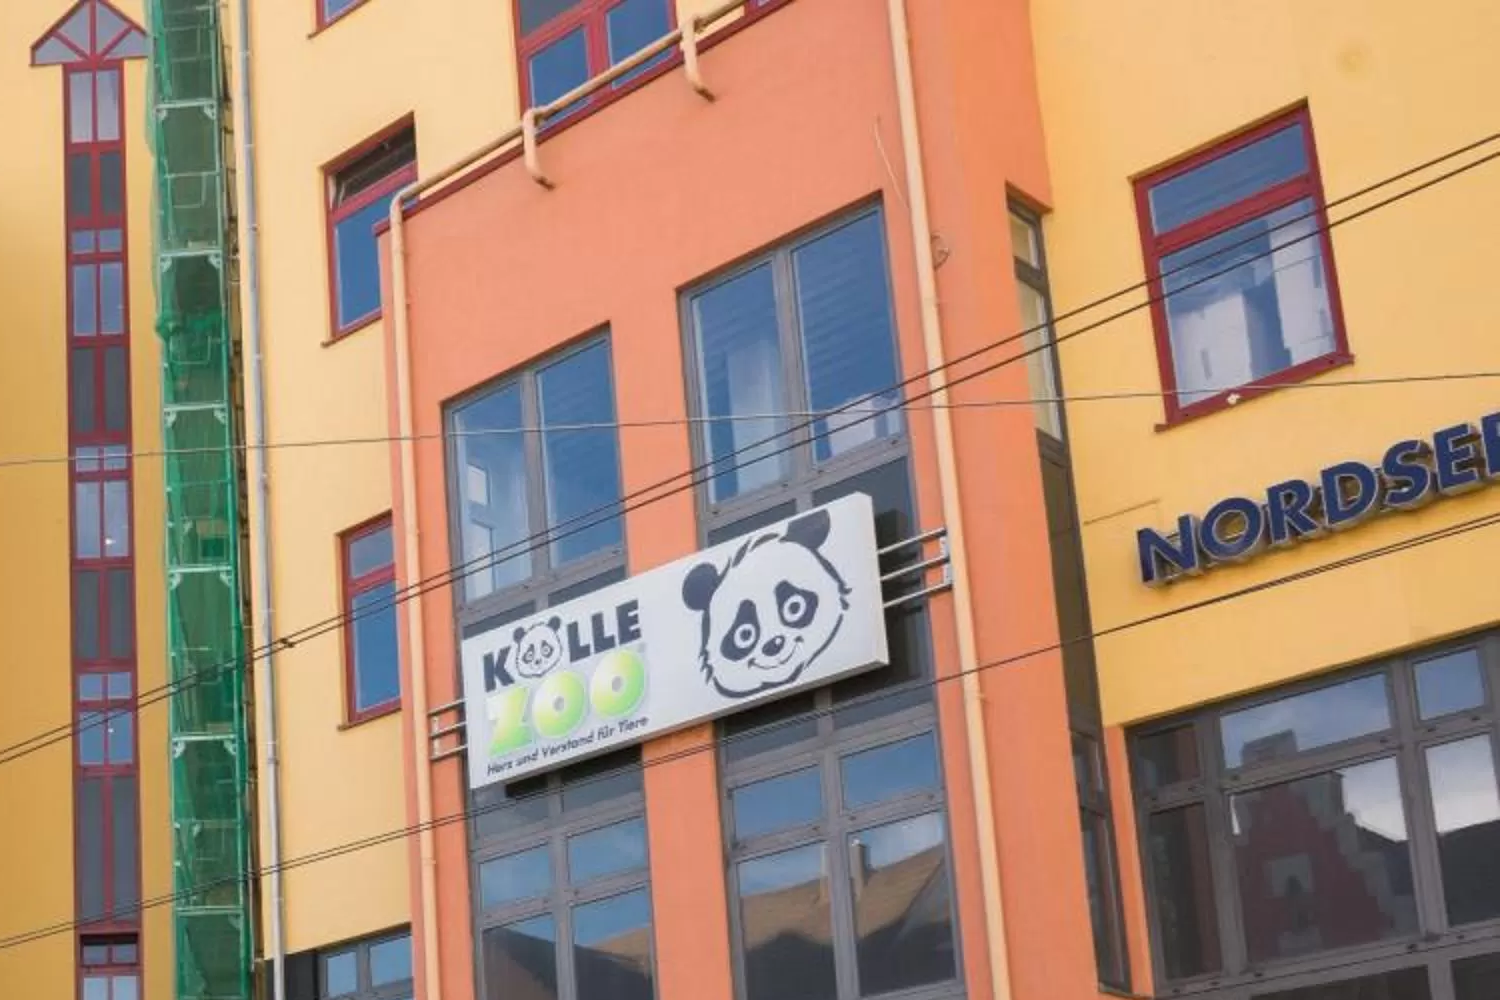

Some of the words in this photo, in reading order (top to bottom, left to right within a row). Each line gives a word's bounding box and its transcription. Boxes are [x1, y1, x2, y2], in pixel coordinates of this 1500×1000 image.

[485, 649, 647, 758] ZOO
[486, 760, 513, 777] Herz
[515, 747, 539, 766] und
[541, 729, 594, 759] Verstand
[597, 724, 616, 741] für
[618, 715, 650, 733] Tiere
